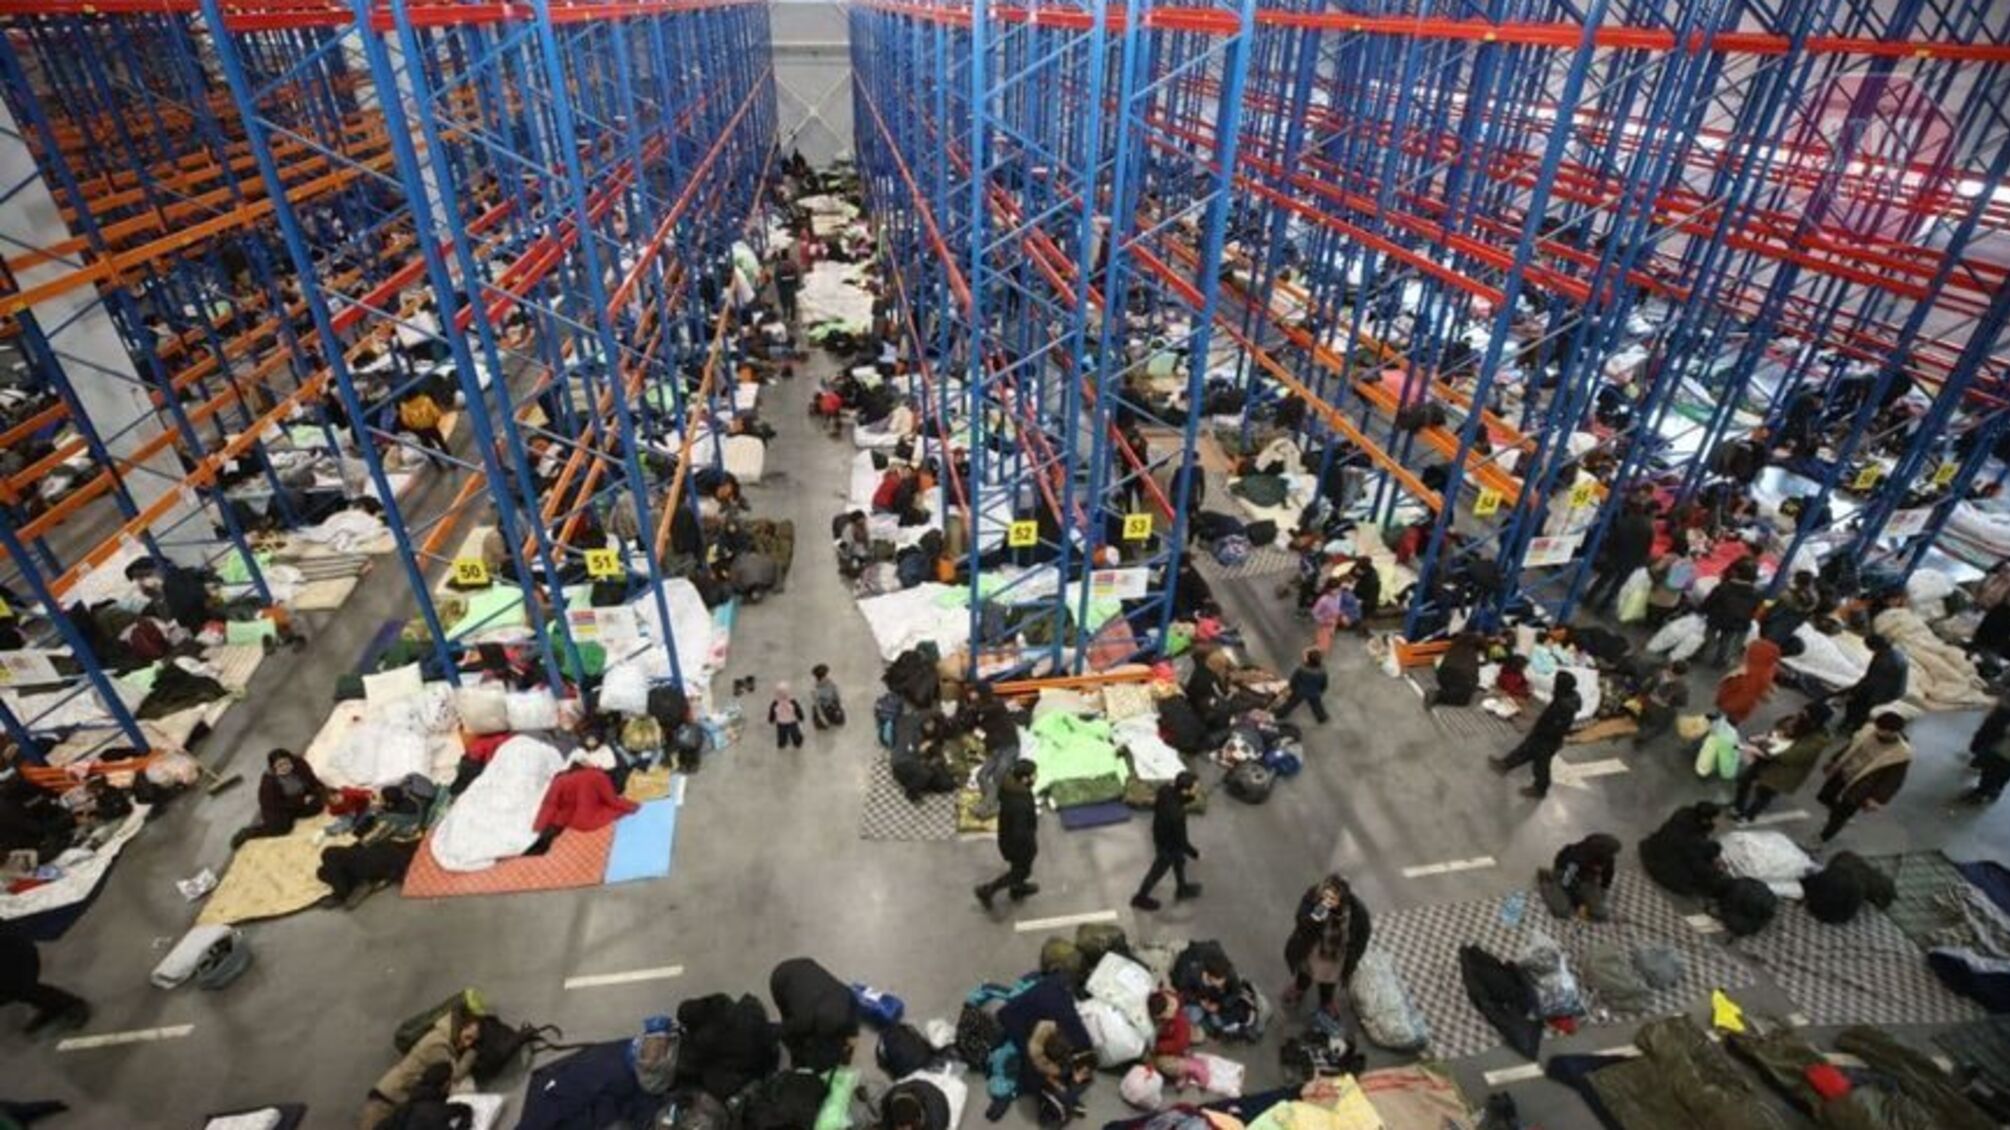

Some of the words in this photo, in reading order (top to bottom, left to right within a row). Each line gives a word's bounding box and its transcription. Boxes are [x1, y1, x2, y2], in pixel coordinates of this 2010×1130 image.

[1015, 526, 1032, 540] 52
[1130, 519, 1147, 533] 53
[592, 555, 612, 569] 51
[459, 564, 481, 578] 50
